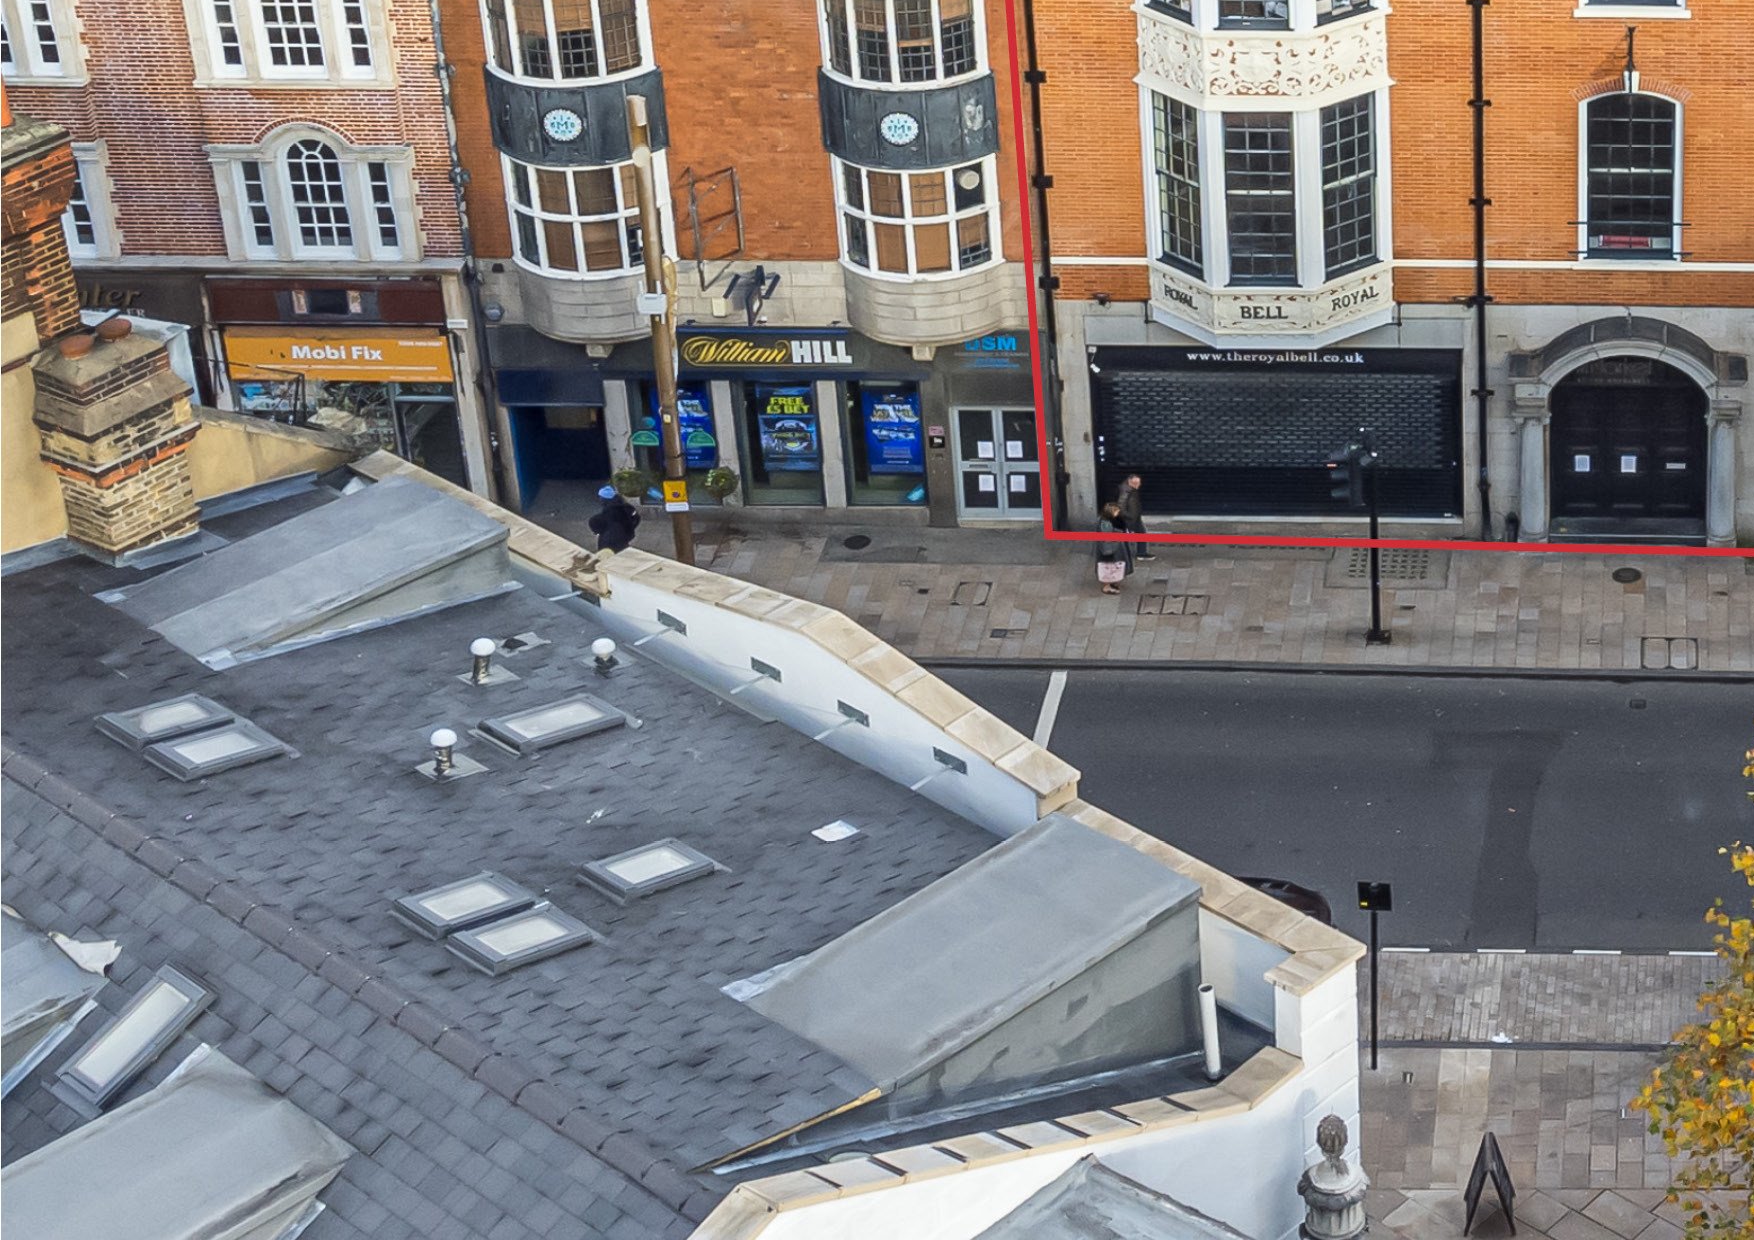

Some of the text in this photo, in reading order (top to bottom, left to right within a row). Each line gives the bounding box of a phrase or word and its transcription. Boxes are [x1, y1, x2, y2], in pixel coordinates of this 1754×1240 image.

[1240, 306, 1289, 320] BELL
[1332, 286, 1380, 311] ROYAL
[291, 344, 384, 361] Mobi Fix
[682, 336, 853, 366] William HILL
[1187, 351, 1365, 364] www.theroyalbell.co.uk
